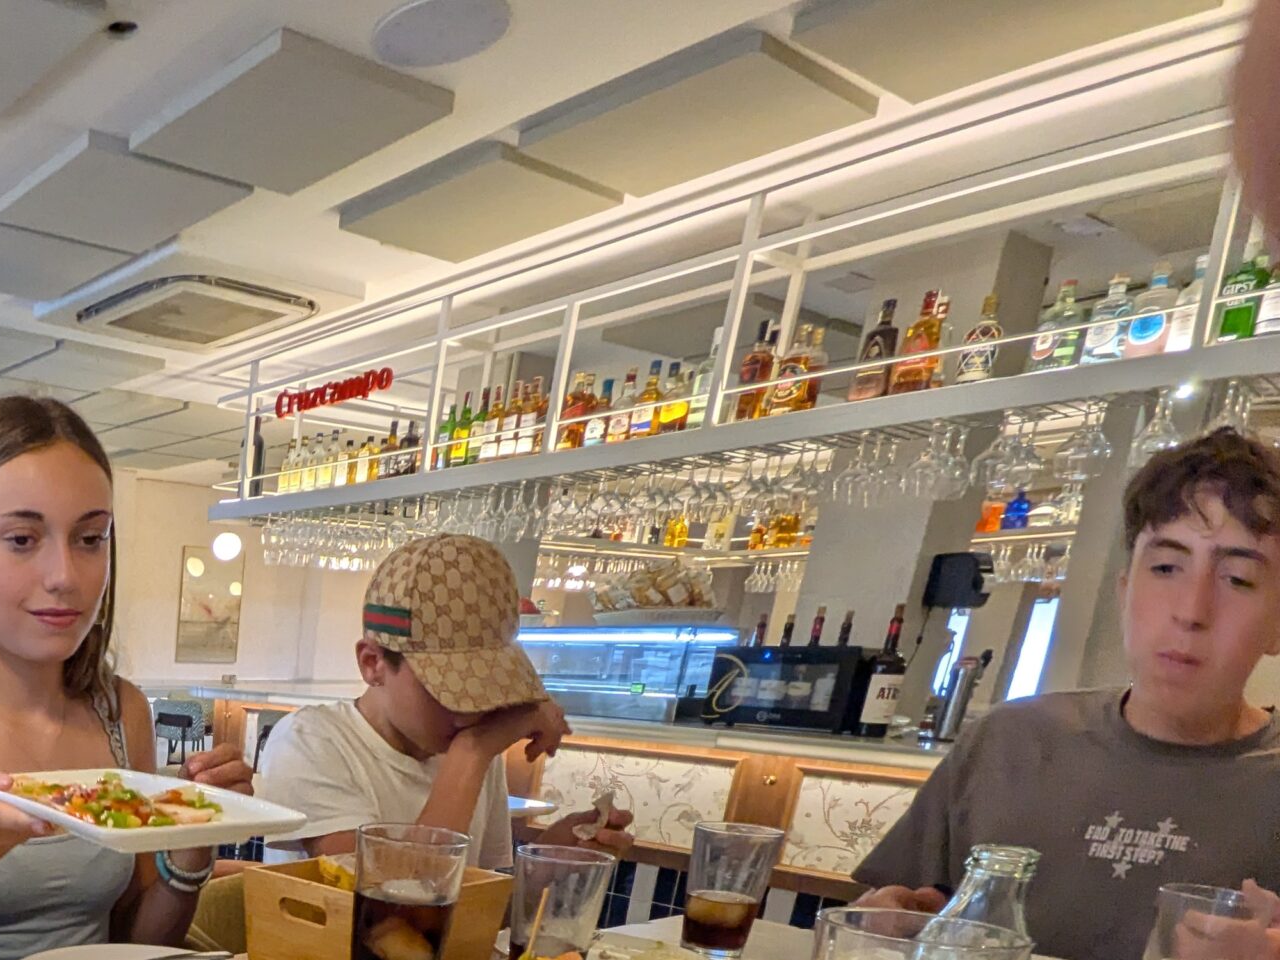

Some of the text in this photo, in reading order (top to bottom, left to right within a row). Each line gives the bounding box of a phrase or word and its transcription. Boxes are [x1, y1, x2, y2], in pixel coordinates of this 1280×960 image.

[275, 367, 394, 418] Cruzcampo
[1088, 842, 1124, 860] FIRST
[1133, 829, 1164, 848] TAKE
[1163, 834, 1191, 852] THE
